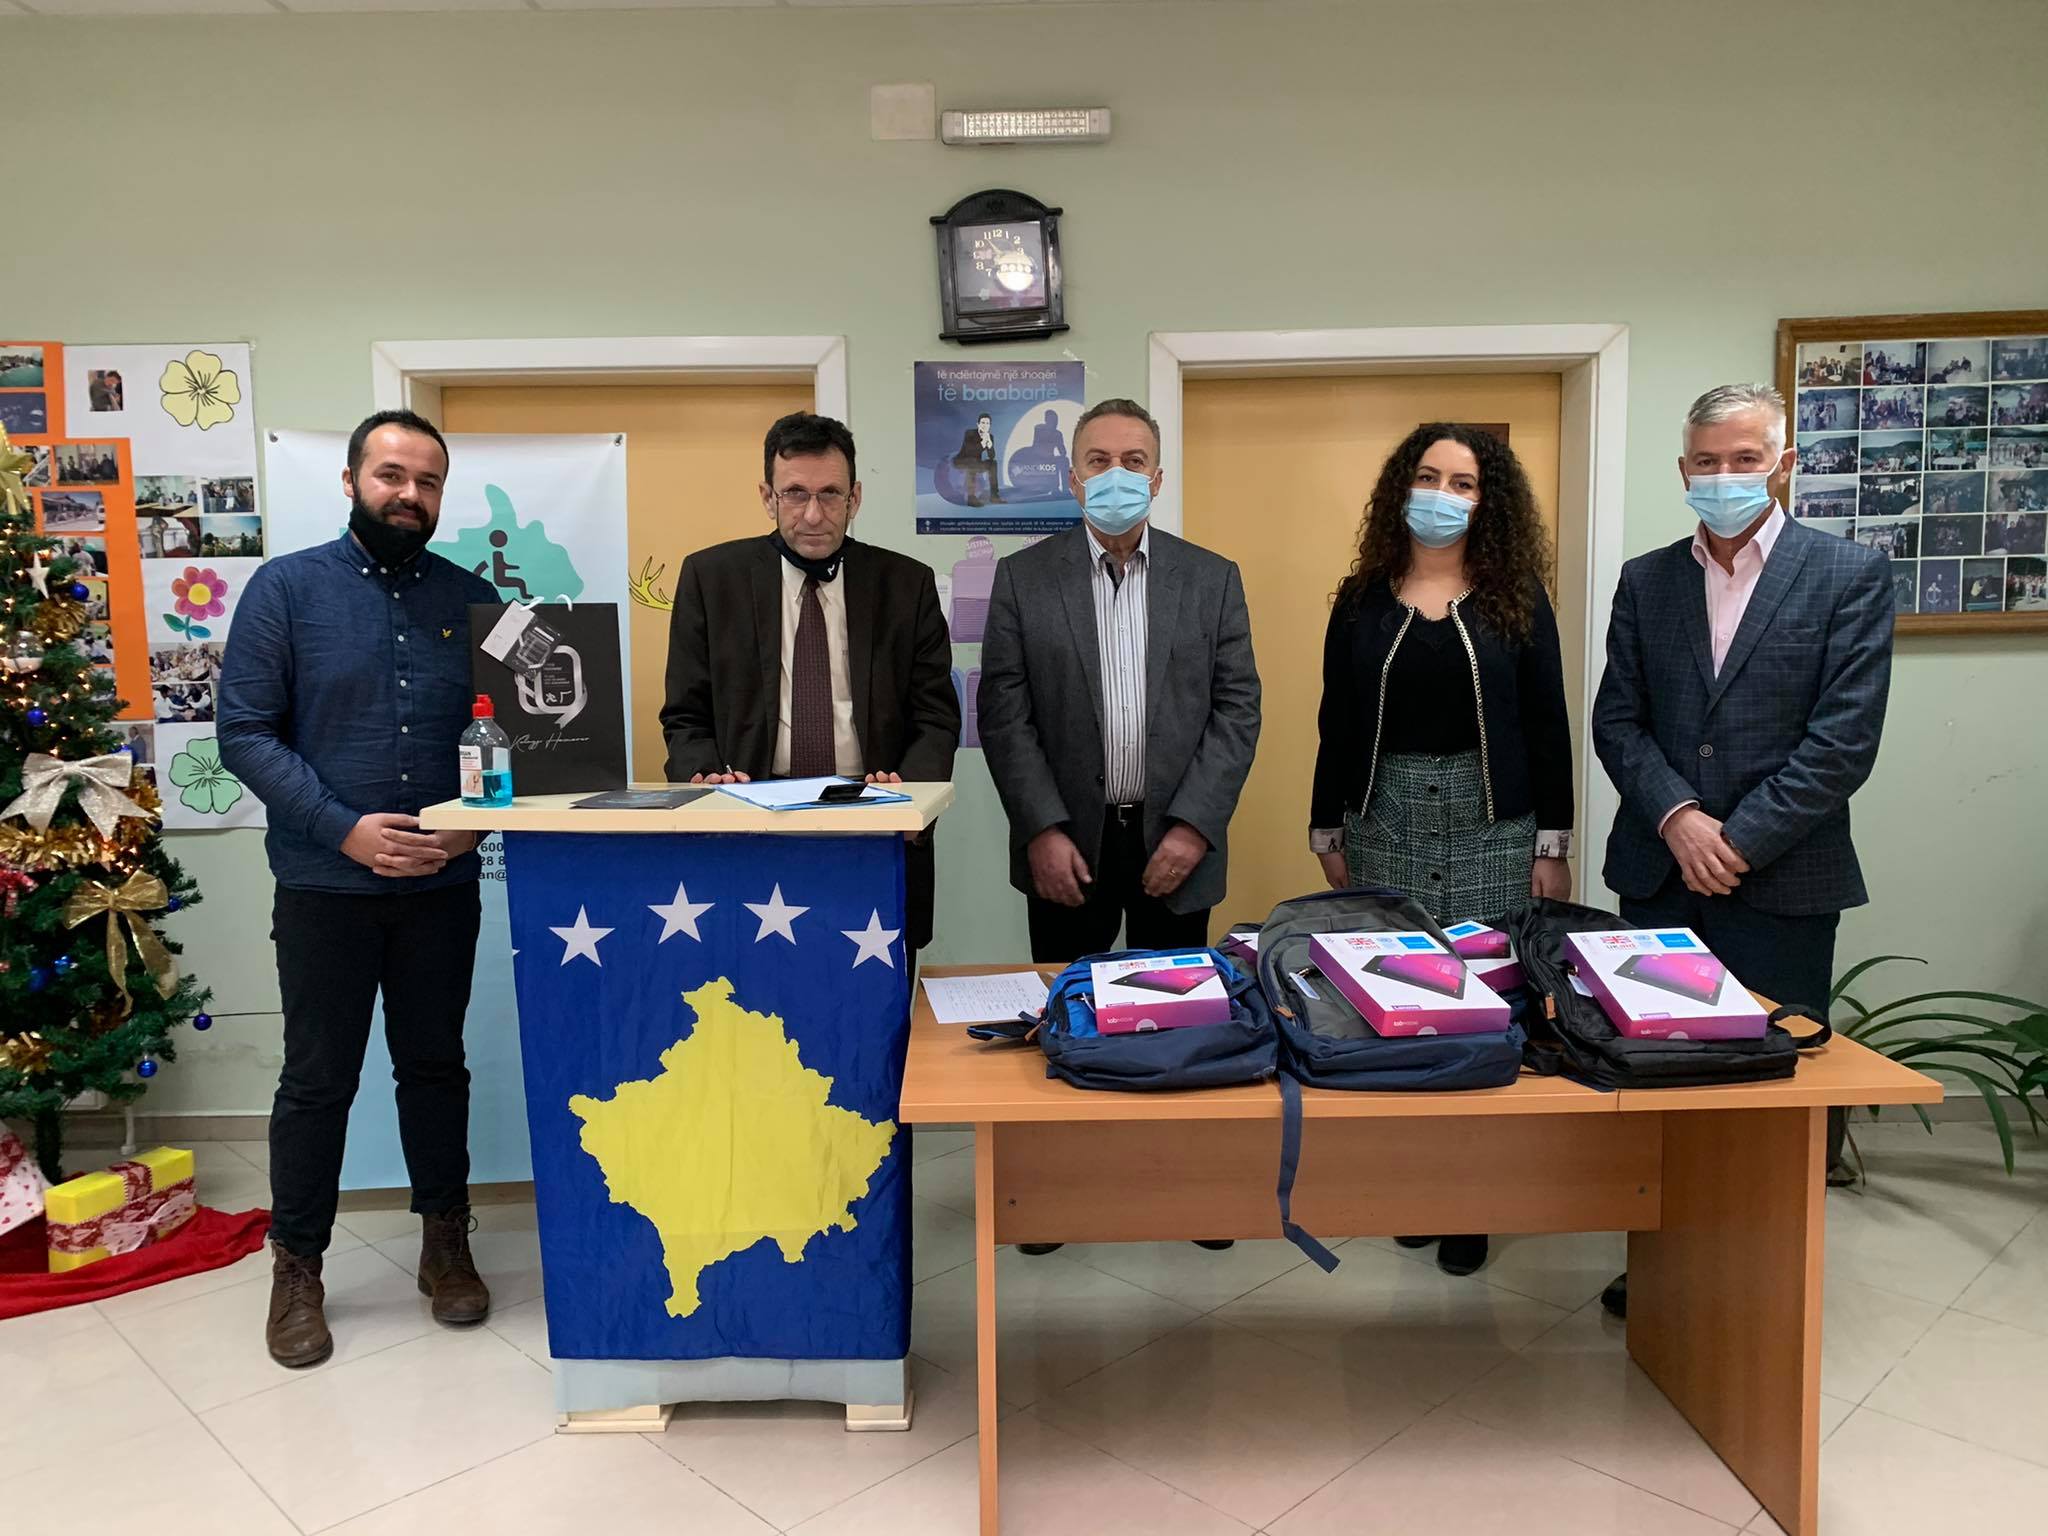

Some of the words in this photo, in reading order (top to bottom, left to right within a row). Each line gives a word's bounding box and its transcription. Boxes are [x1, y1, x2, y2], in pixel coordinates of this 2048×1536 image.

[983, 231, 992, 240] 11
[992, 228, 1003, 238] 12
[974, 239, 985, 248] 10
[1013, 236, 1021, 244] 2
[976, 261, 984, 270] 8
[985, 268, 992, 277] 7
[938, 384, 957, 402] të
[962, 383, 1058, 402] barabartë
[480, 842, 504, 853] 600
